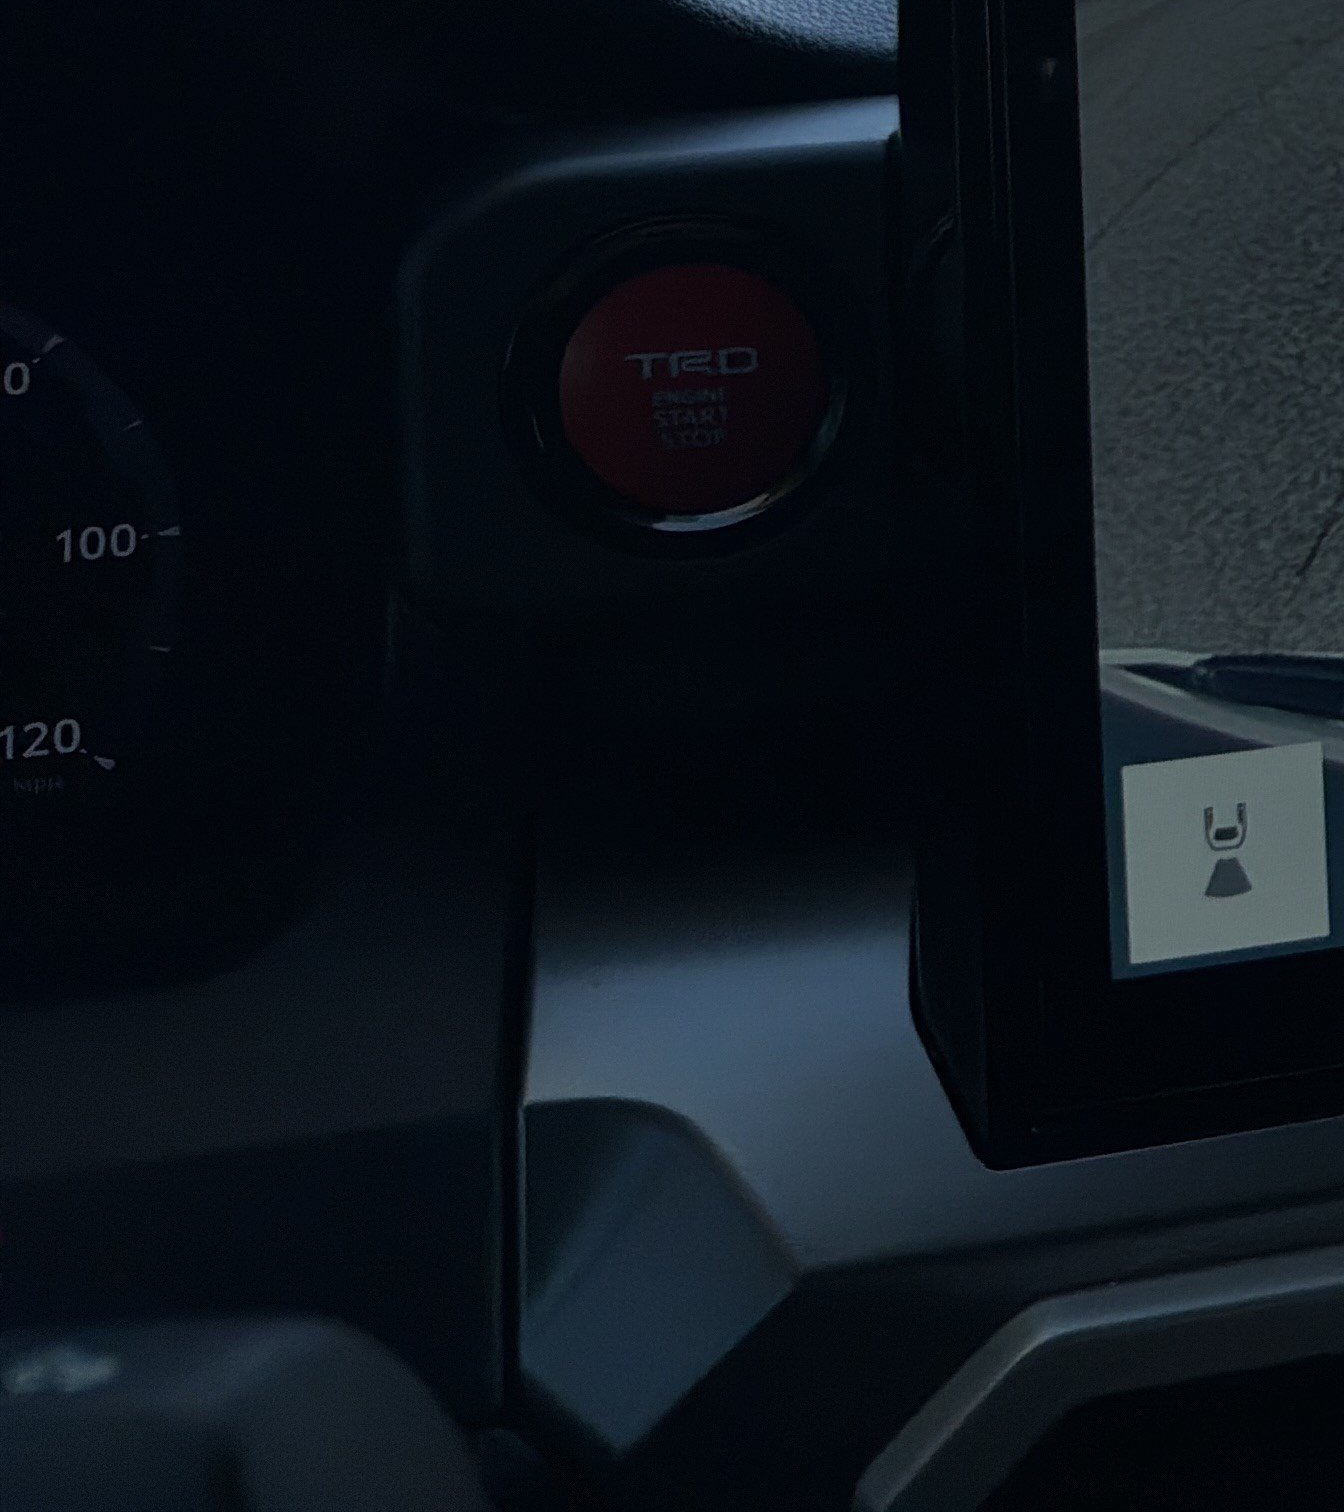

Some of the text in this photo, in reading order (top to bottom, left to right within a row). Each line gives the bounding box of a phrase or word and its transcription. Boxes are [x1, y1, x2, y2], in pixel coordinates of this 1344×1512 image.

[624, 346, 759, 380] TRD
[55, 523, 137, 563] 100
[0, 717, 82, 761] 120
